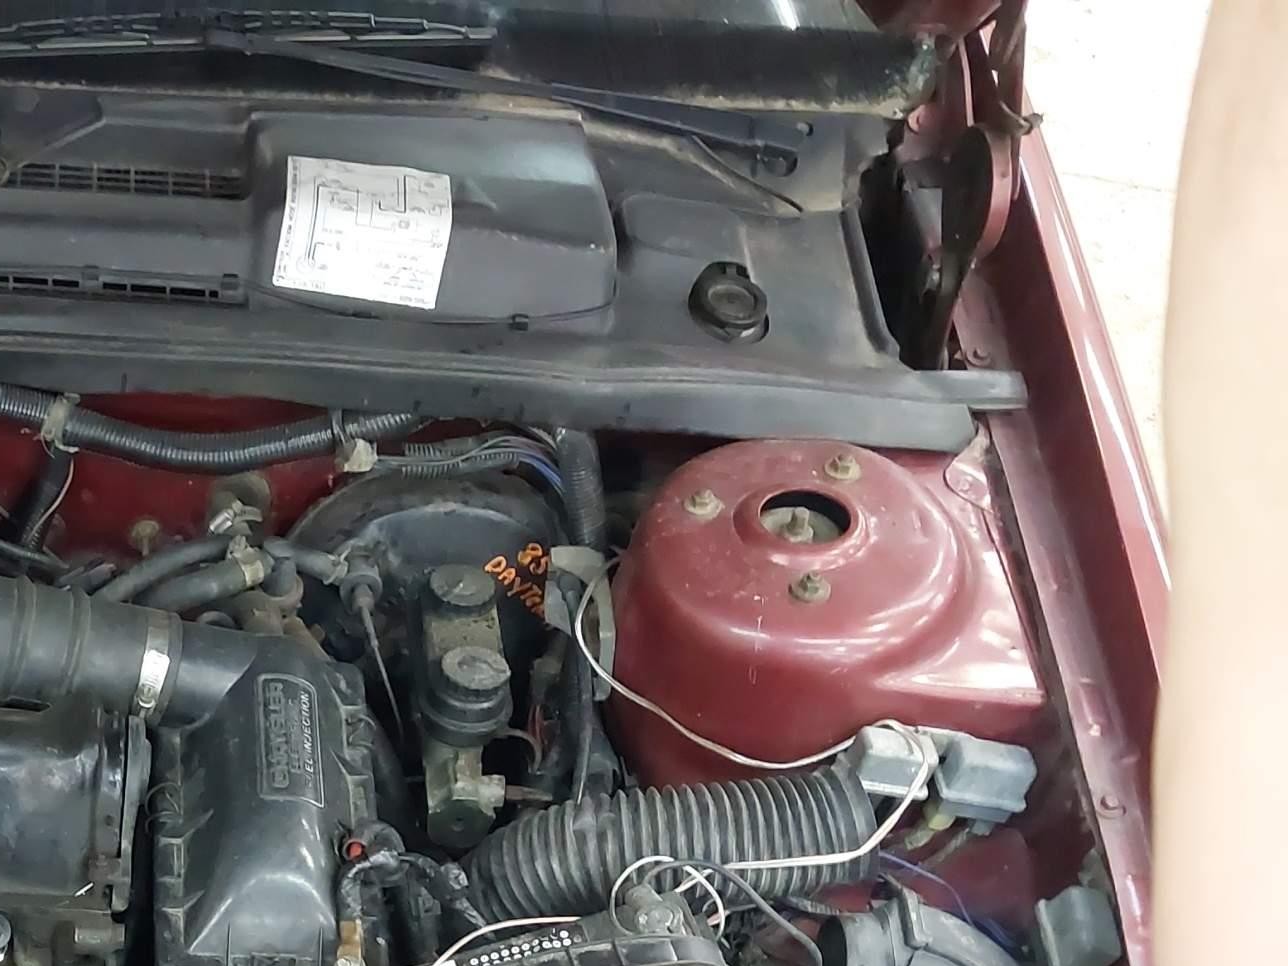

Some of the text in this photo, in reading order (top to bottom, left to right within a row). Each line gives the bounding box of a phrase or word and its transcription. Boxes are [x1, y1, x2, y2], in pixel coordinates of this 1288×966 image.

[517, 543, 548, 575] 85
[269, 682, 289, 788] CHRYSLER
[299, 691, 313, 756] INJECTION
